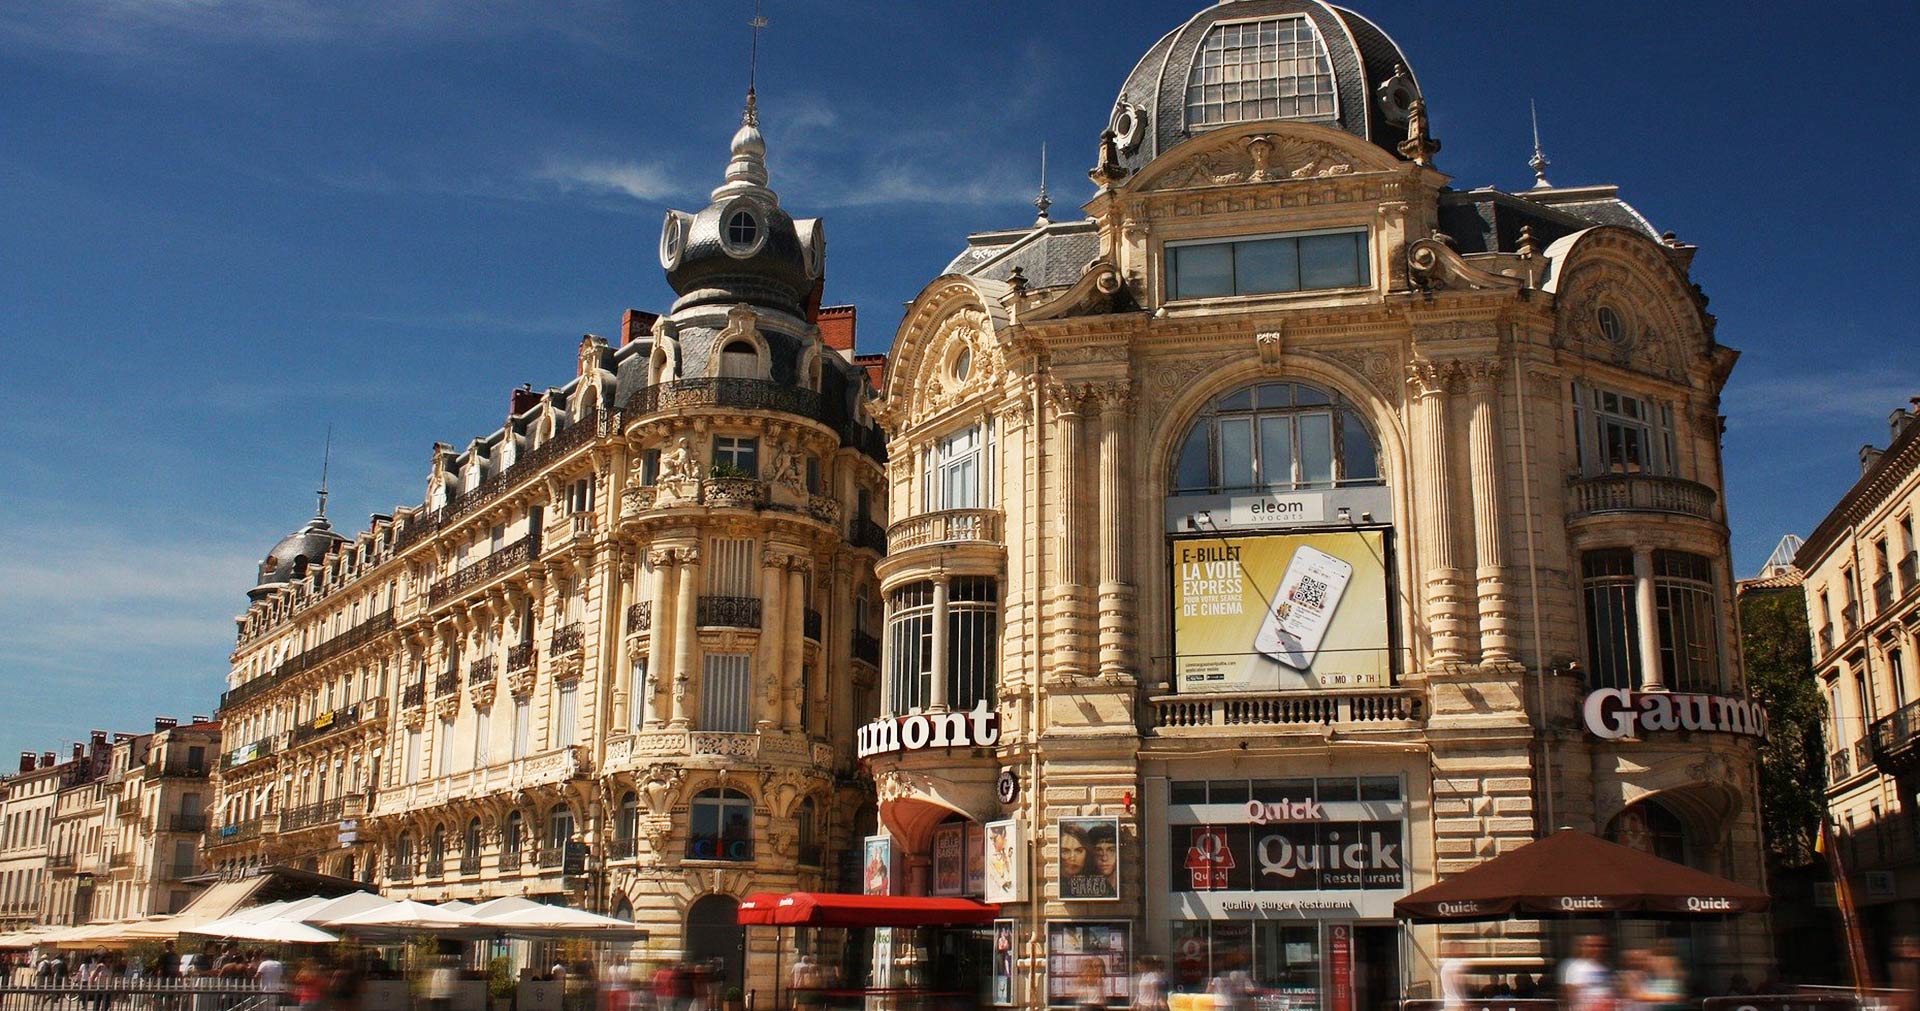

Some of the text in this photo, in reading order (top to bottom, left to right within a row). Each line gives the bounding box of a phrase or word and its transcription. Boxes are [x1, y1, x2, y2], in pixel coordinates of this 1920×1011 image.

[1251, 499, 1303, 514] eleom
[1251, 513, 1303, 521] avocats
[1182, 546, 1241, 563] E-BILLET
[1182, 561, 1242, 580] LA VOIE
[1183, 579, 1243, 596] EXPRESS
[1183, 602, 1243, 617] DE CINEMA
[1243, 798, 1322, 825] Quick
[1258, 832, 1399, 877] Quick
[1194, 872, 1226, 884] Quick
[1323, 872, 1401, 884] Restaurant
[1221, 899, 1351, 912] Quality Burger Restaurant
[1437, 900, 1478, 916] Quick
[1561, 896, 1602, 911] Quick
[1687, 896, 1730, 912] Quick
